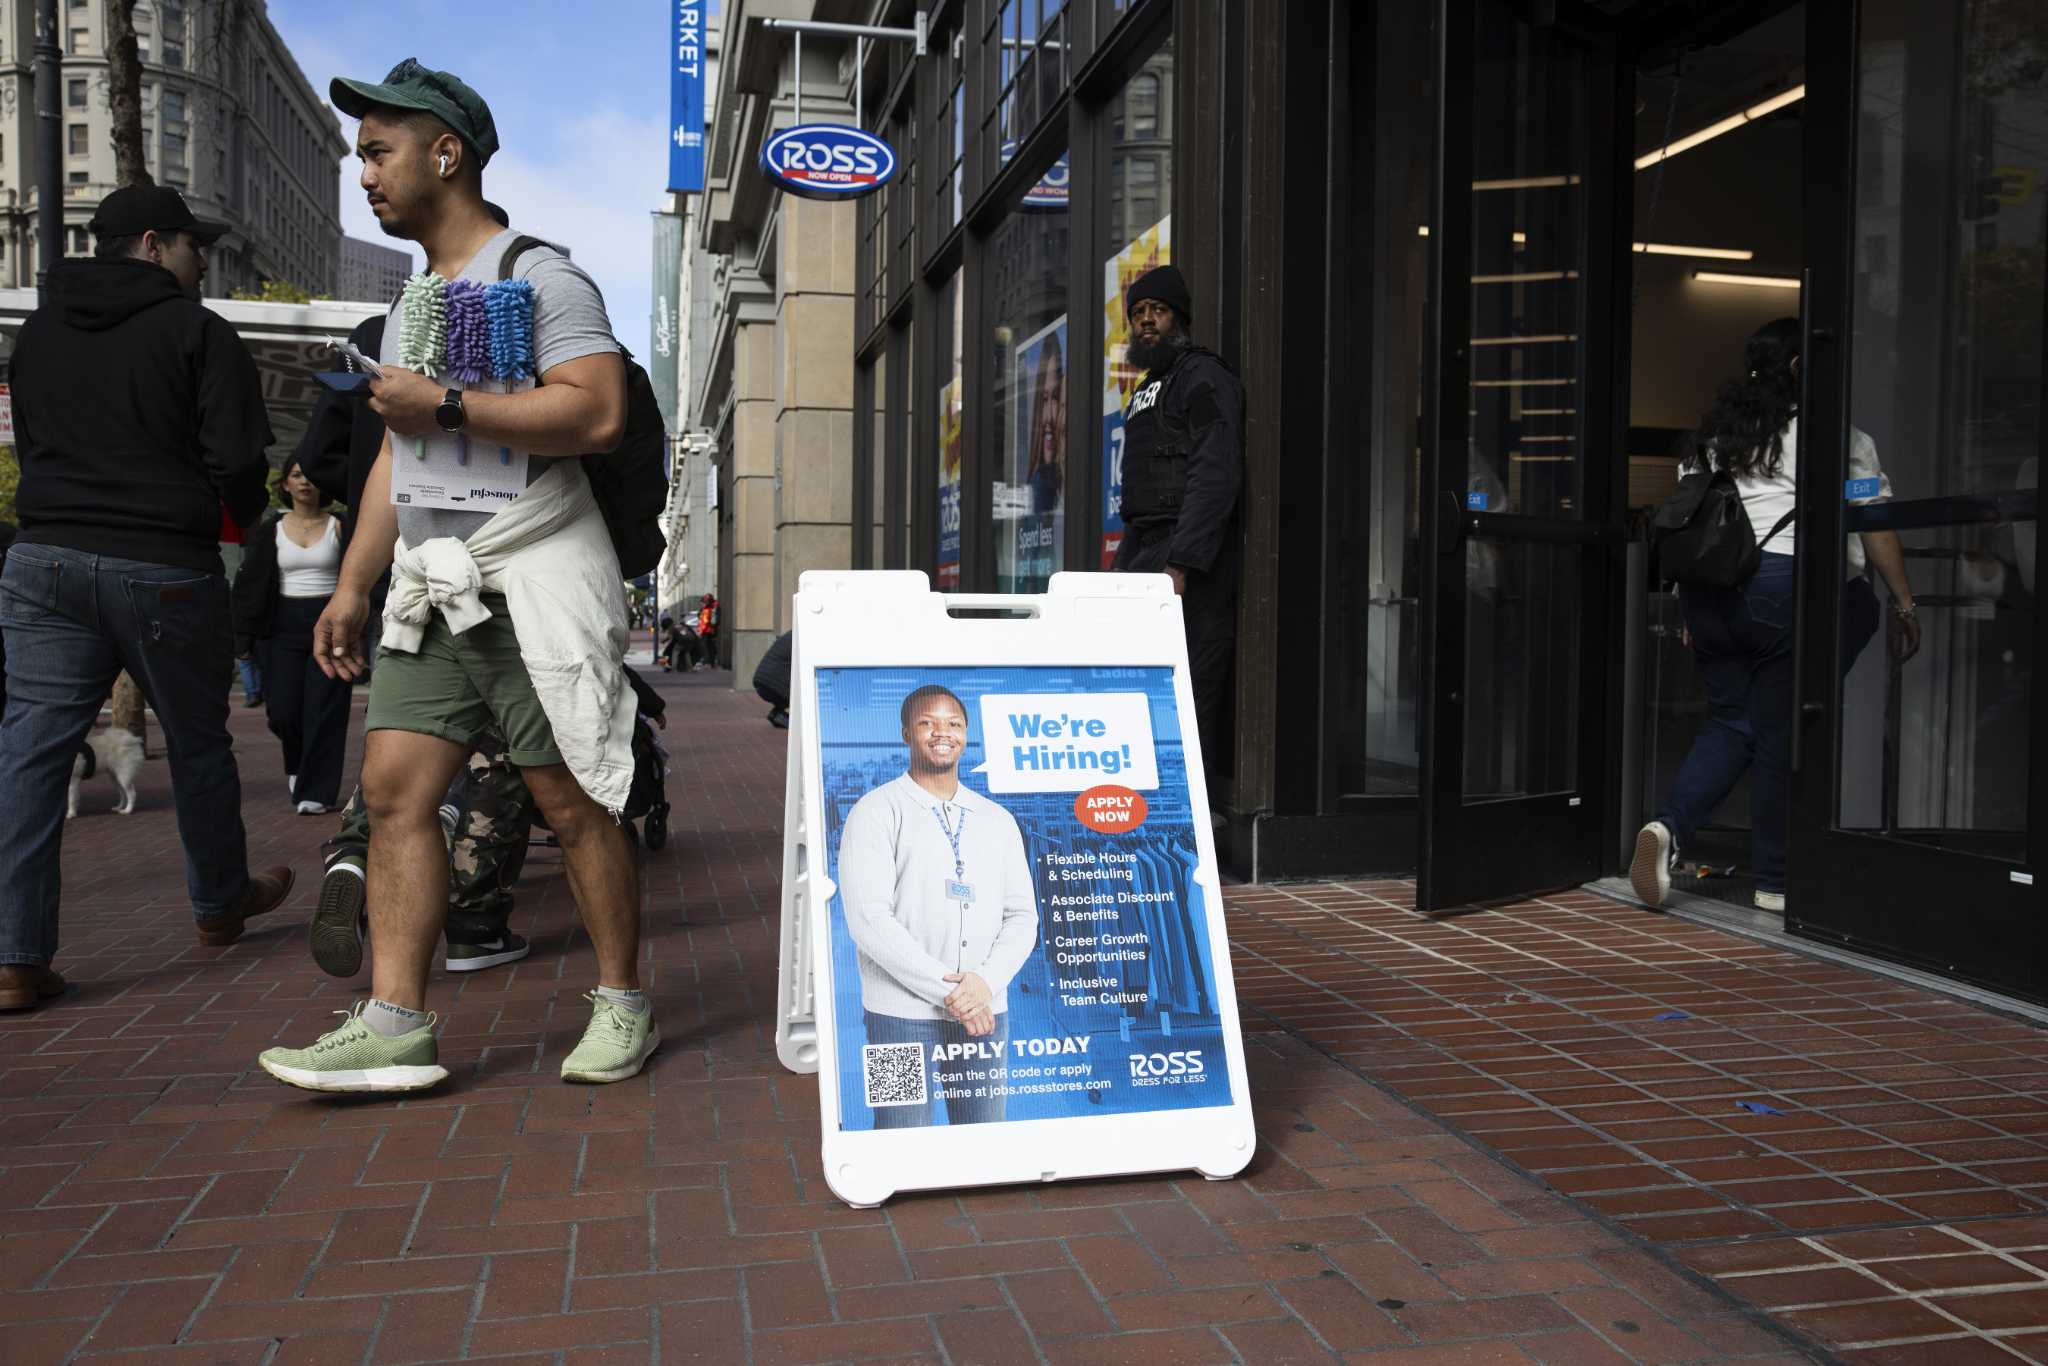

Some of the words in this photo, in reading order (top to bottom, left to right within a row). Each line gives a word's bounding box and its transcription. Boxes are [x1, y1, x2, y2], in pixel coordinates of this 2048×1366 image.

[783, 141, 878, 174] ROSS
[808, 172, 828, 180] NOW
[829, 173, 852, 181] OPEN
[1012, 744, 1132, 774] Hiring!
[1086, 796, 1134, 809] APPLY
[1094, 811, 1130, 823] NOW
[1046, 853, 1096, 865] Flexible
[1099, 852, 1137, 864] Hours
[1048, 870, 1058, 881] &
[1062, 868, 1133, 881] Scheduling
[1051, 893, 1114, 906] Associate
[1117, 891, 1174, 903] Discount
[1053, 912, 1062, 922] &
[1066, 909, 1119, 922] Benefits
[1055, 936, 1098, 948] Career
[1102, 933, 1148, 945] Growth
[1057, 950, 1146, 966] Opportunities
[1059, 976, 1118, 990] Inclusive
[1061, 994, 1096, 1007] Team
[1100, 992, 1148, 1004] Culture
[374, 1000, 416, 1018] Hurley
[931, 1040, 1006, 1062] APPLY
[1012, 1036, 1091, 1057] TODAY
[1129, 1050, 1204, 1077] ROSS
[932, 1070, 963, 1083] Scan
[965, 1069, 987, 1081] the
[988, 1068, 1008, 1080] QR
[1011, 1066, 1042, 1078] code
[1044, 1066, 1062, 1077] or
[1064, 1063, 1093, 1078] apply
[1132, 1077, 1161, 1087] DRESS
[1163, 1076, 1181, 1085] FOR
[1183, 1074, 1206, 1083] LESS
[933, 1086, 972, 1099] online
[974, 1087, 988, 1098] at
[989, 1078, 1111, 1097] jobs.rossstores.com
